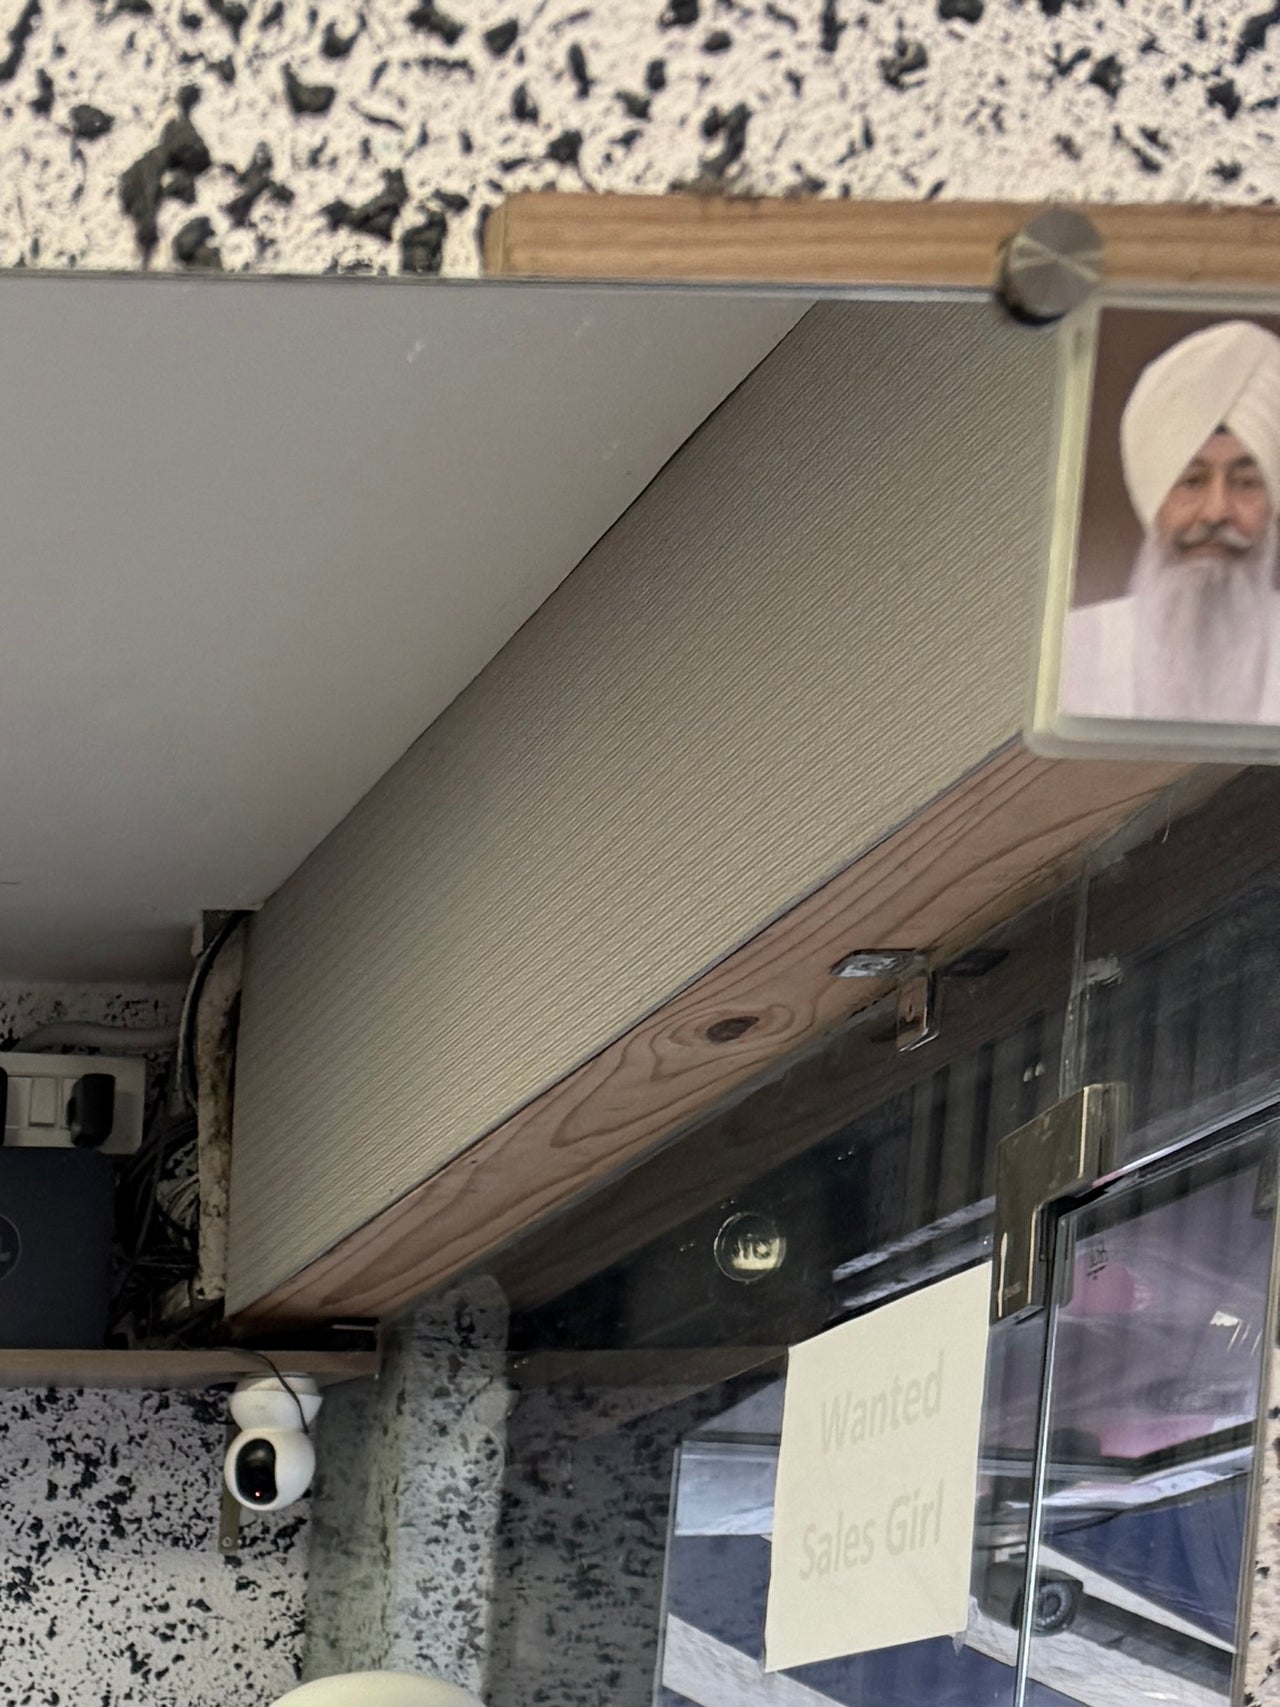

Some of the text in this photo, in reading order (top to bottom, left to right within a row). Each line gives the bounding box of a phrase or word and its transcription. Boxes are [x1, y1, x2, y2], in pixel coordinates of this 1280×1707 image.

[820, 1350, 945, 1455] Wanted
[798, 1477, 945, 1582] Sales Girl
